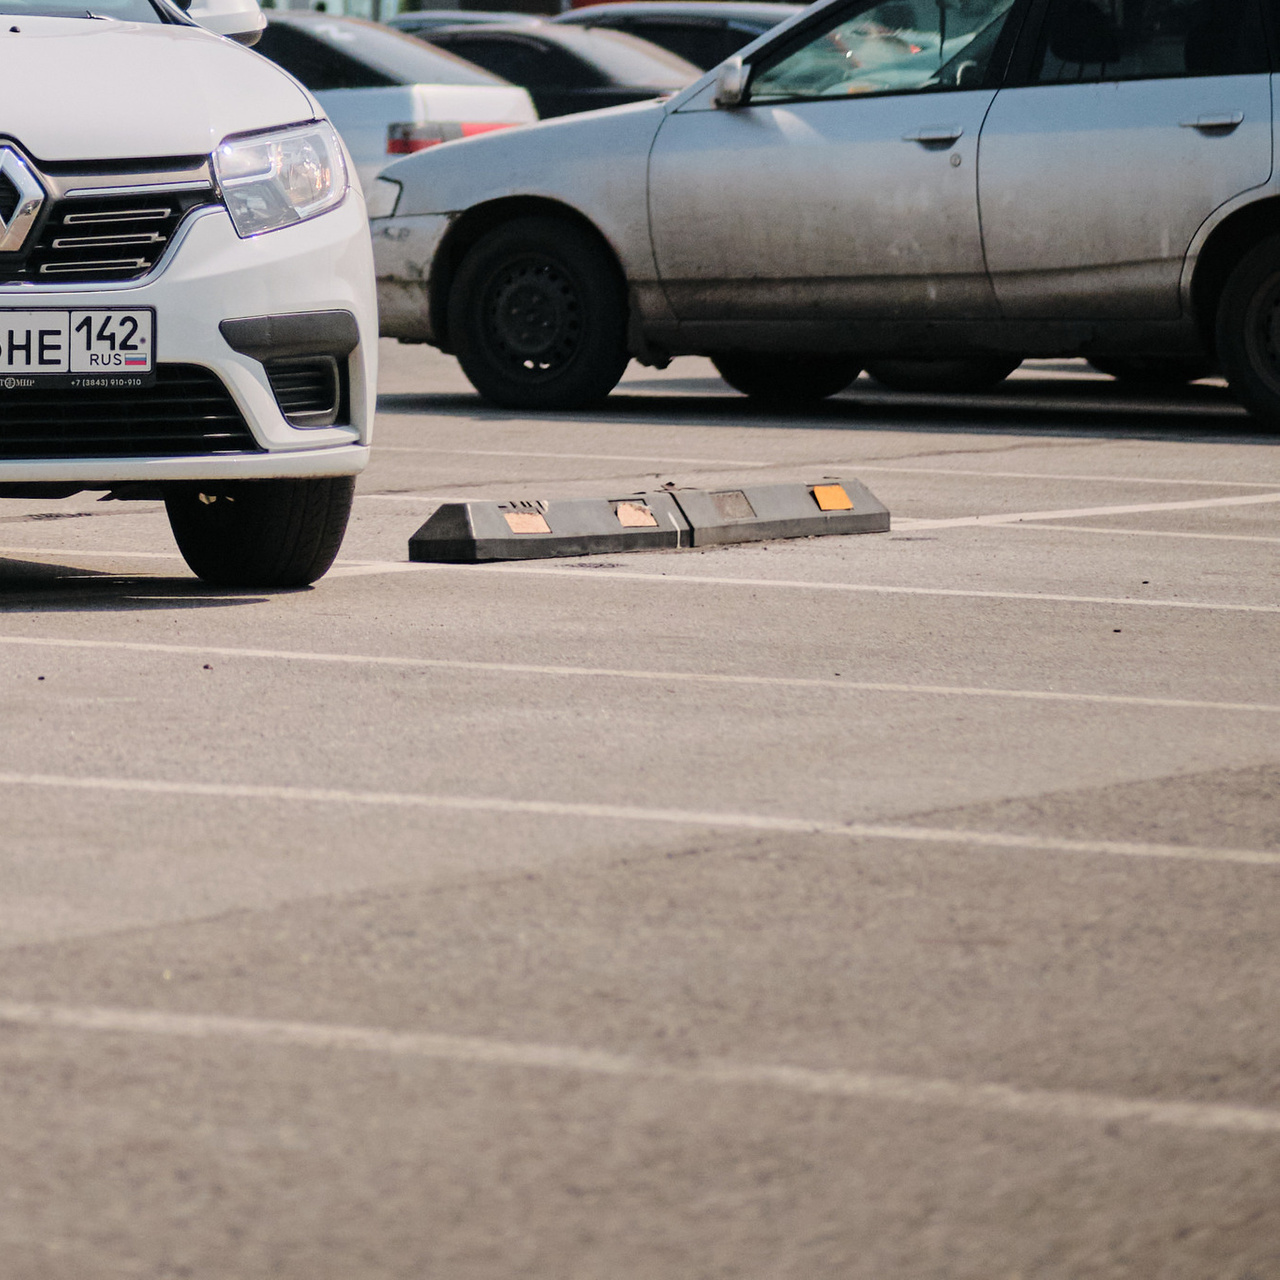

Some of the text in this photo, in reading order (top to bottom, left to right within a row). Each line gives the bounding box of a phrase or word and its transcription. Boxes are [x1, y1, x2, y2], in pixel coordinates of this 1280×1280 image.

[75, 315, 138, 351] 142
[89, 353, 122, 366] RUS
[71, 377, 142, 388] +7 (3843) 910-910
